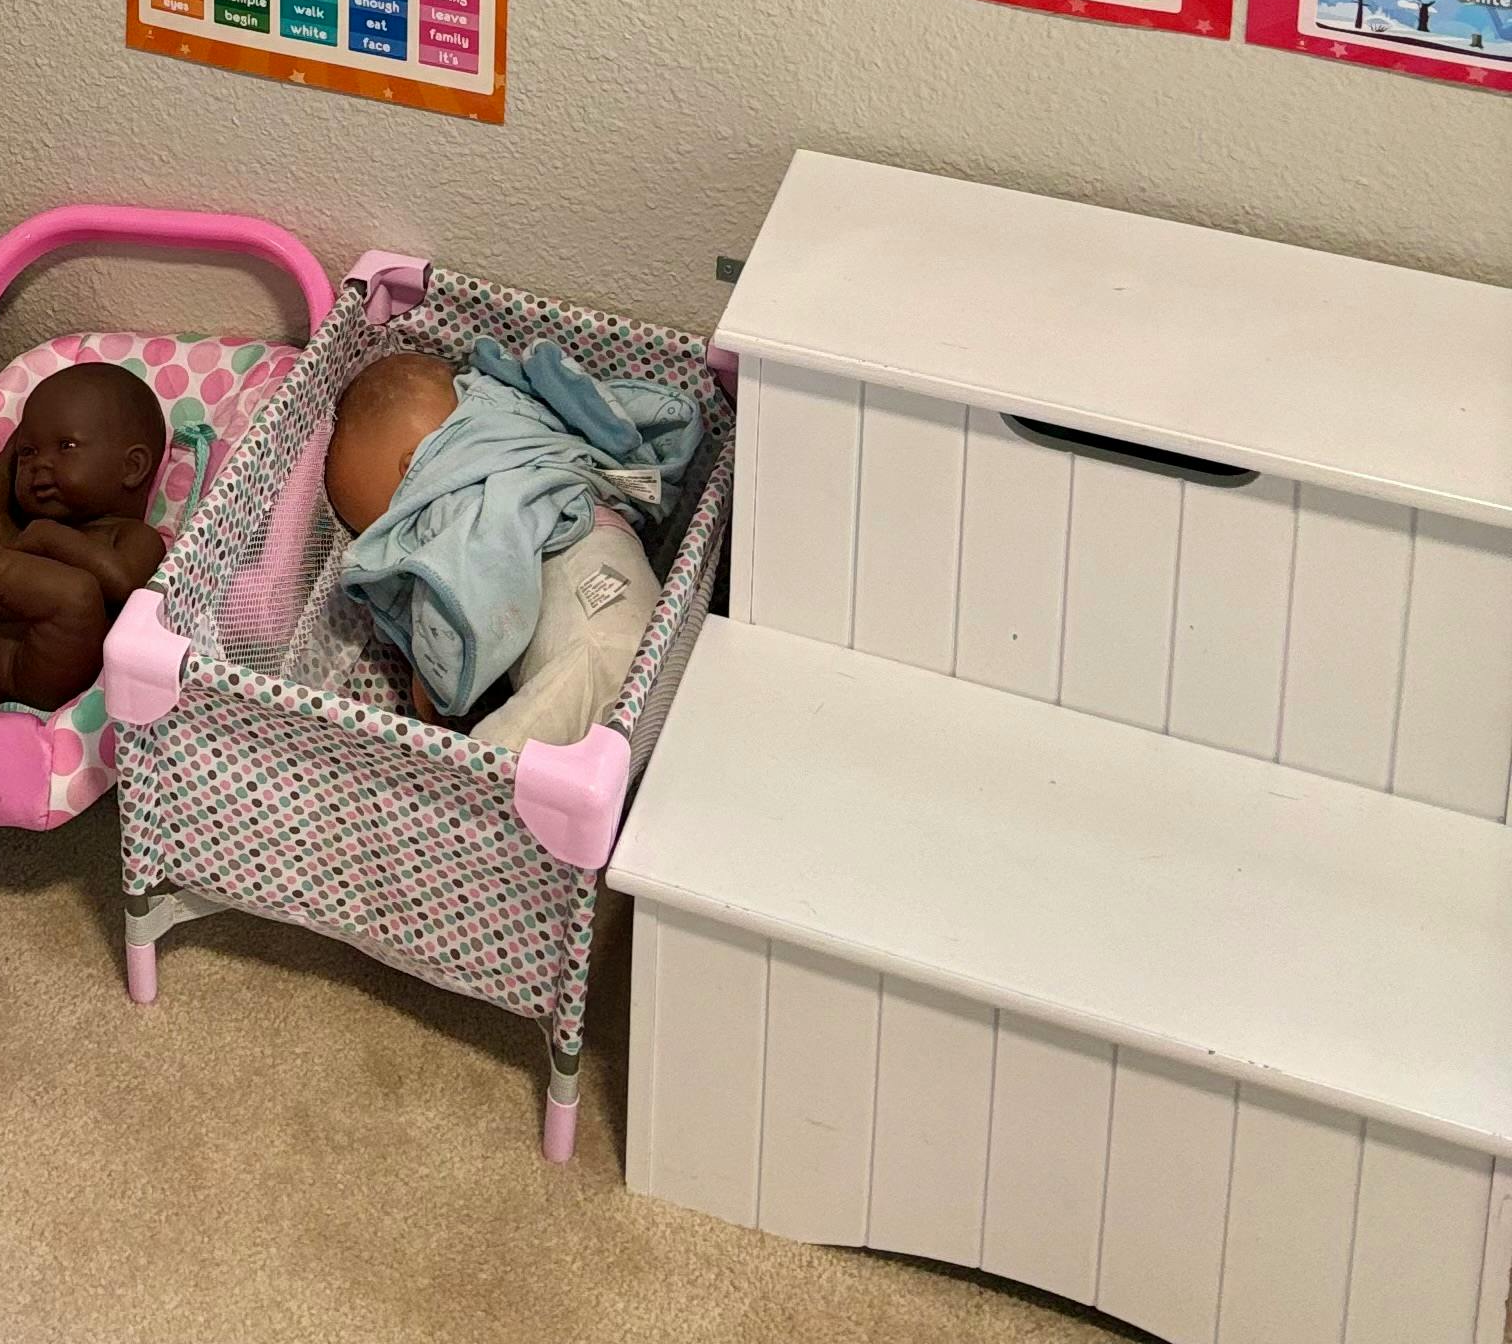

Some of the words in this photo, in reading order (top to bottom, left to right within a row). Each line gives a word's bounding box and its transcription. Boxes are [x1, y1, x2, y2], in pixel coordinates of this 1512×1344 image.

[224, 9, 257, 26] begin
[293, 5, 324, 18] walk
[431, 7, 467, 24] leave
[290, 24, 327, 40] white
[366, 19, 387, 31] eat
[363, 37, 390, 52] face
[429, 28, 469, 48] family
